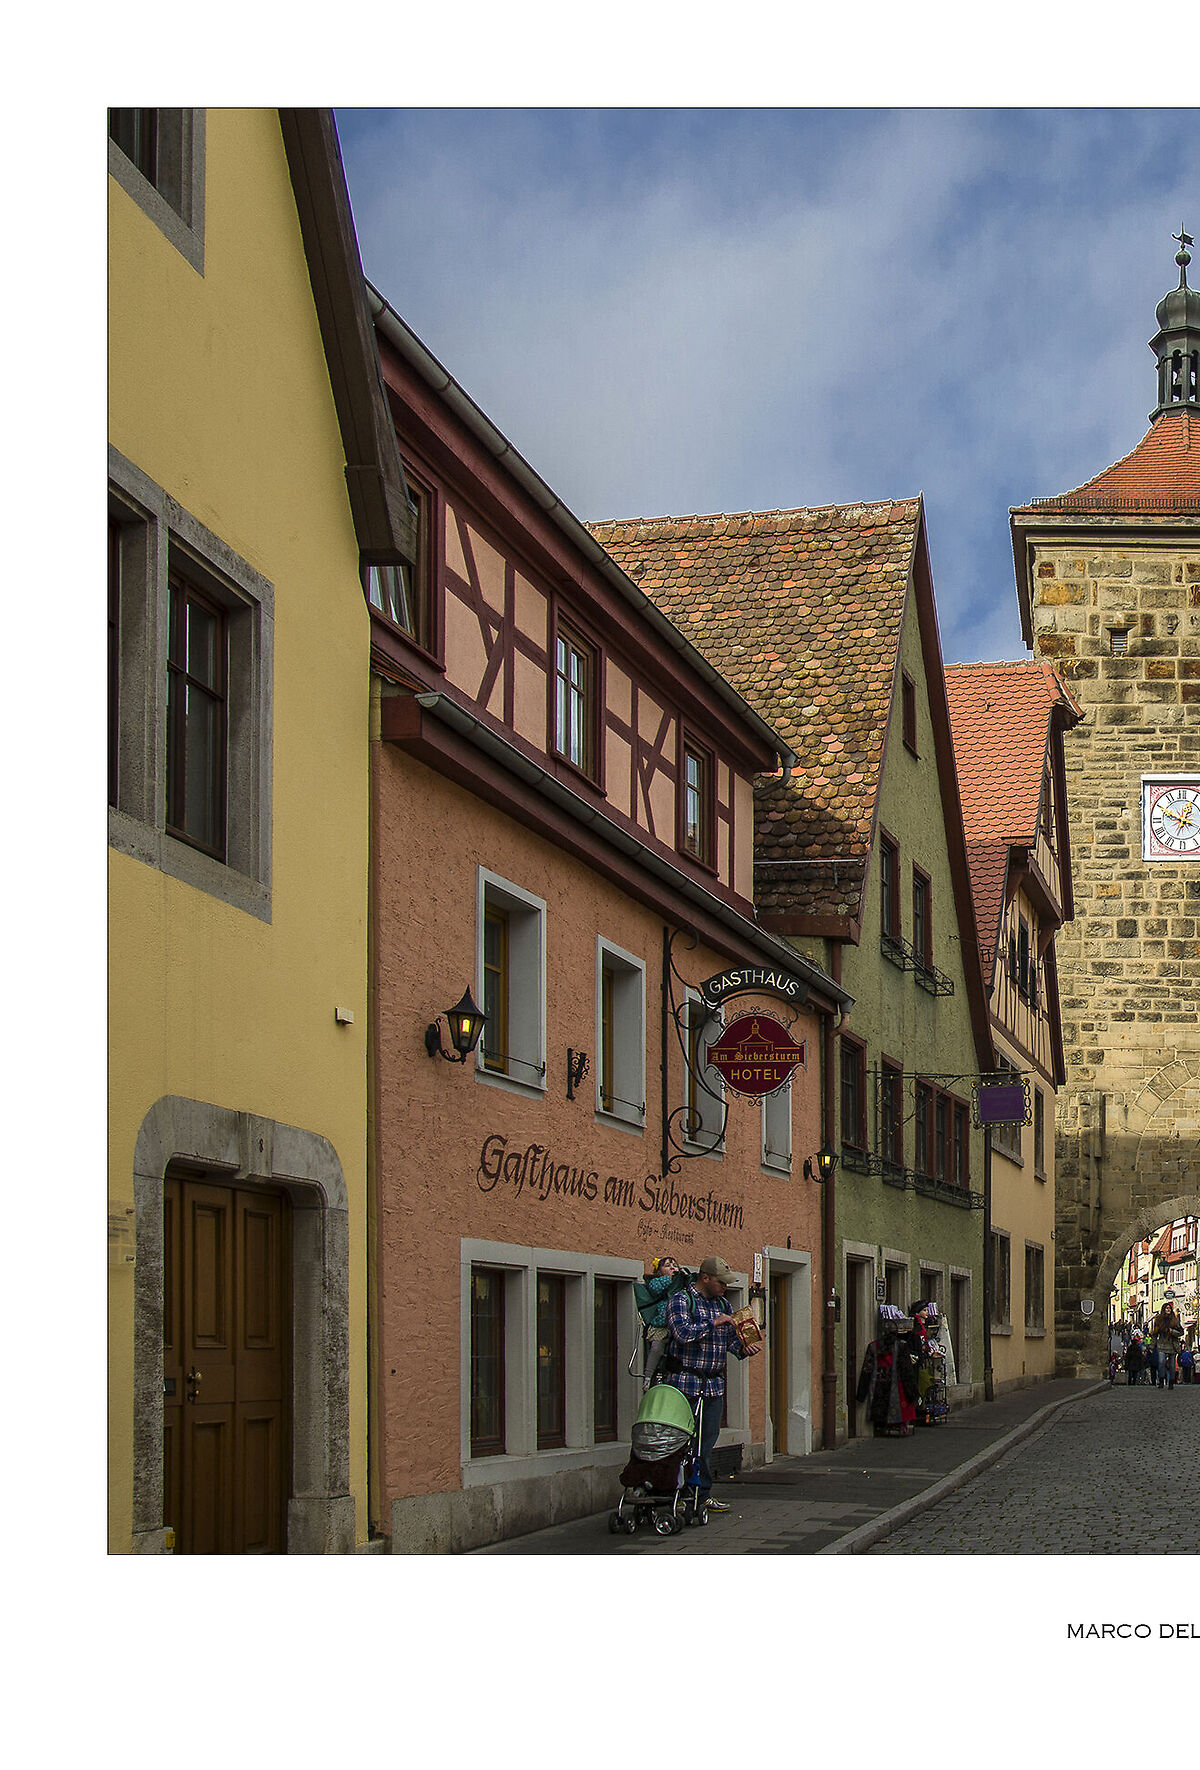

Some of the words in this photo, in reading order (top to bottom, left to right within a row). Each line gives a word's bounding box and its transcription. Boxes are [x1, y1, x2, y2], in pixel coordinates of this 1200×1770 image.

[709, 969, 800, 996] GASTHAUS
[710, 1053, 728, 1061] Am
[734, 1051, 800, 1061] Siebersturm
[730, 1068, 781, 1080] HOTEL
[603, 1175, 635, 1208] am
[638, 1174, 745, 1230] Siebersturm
